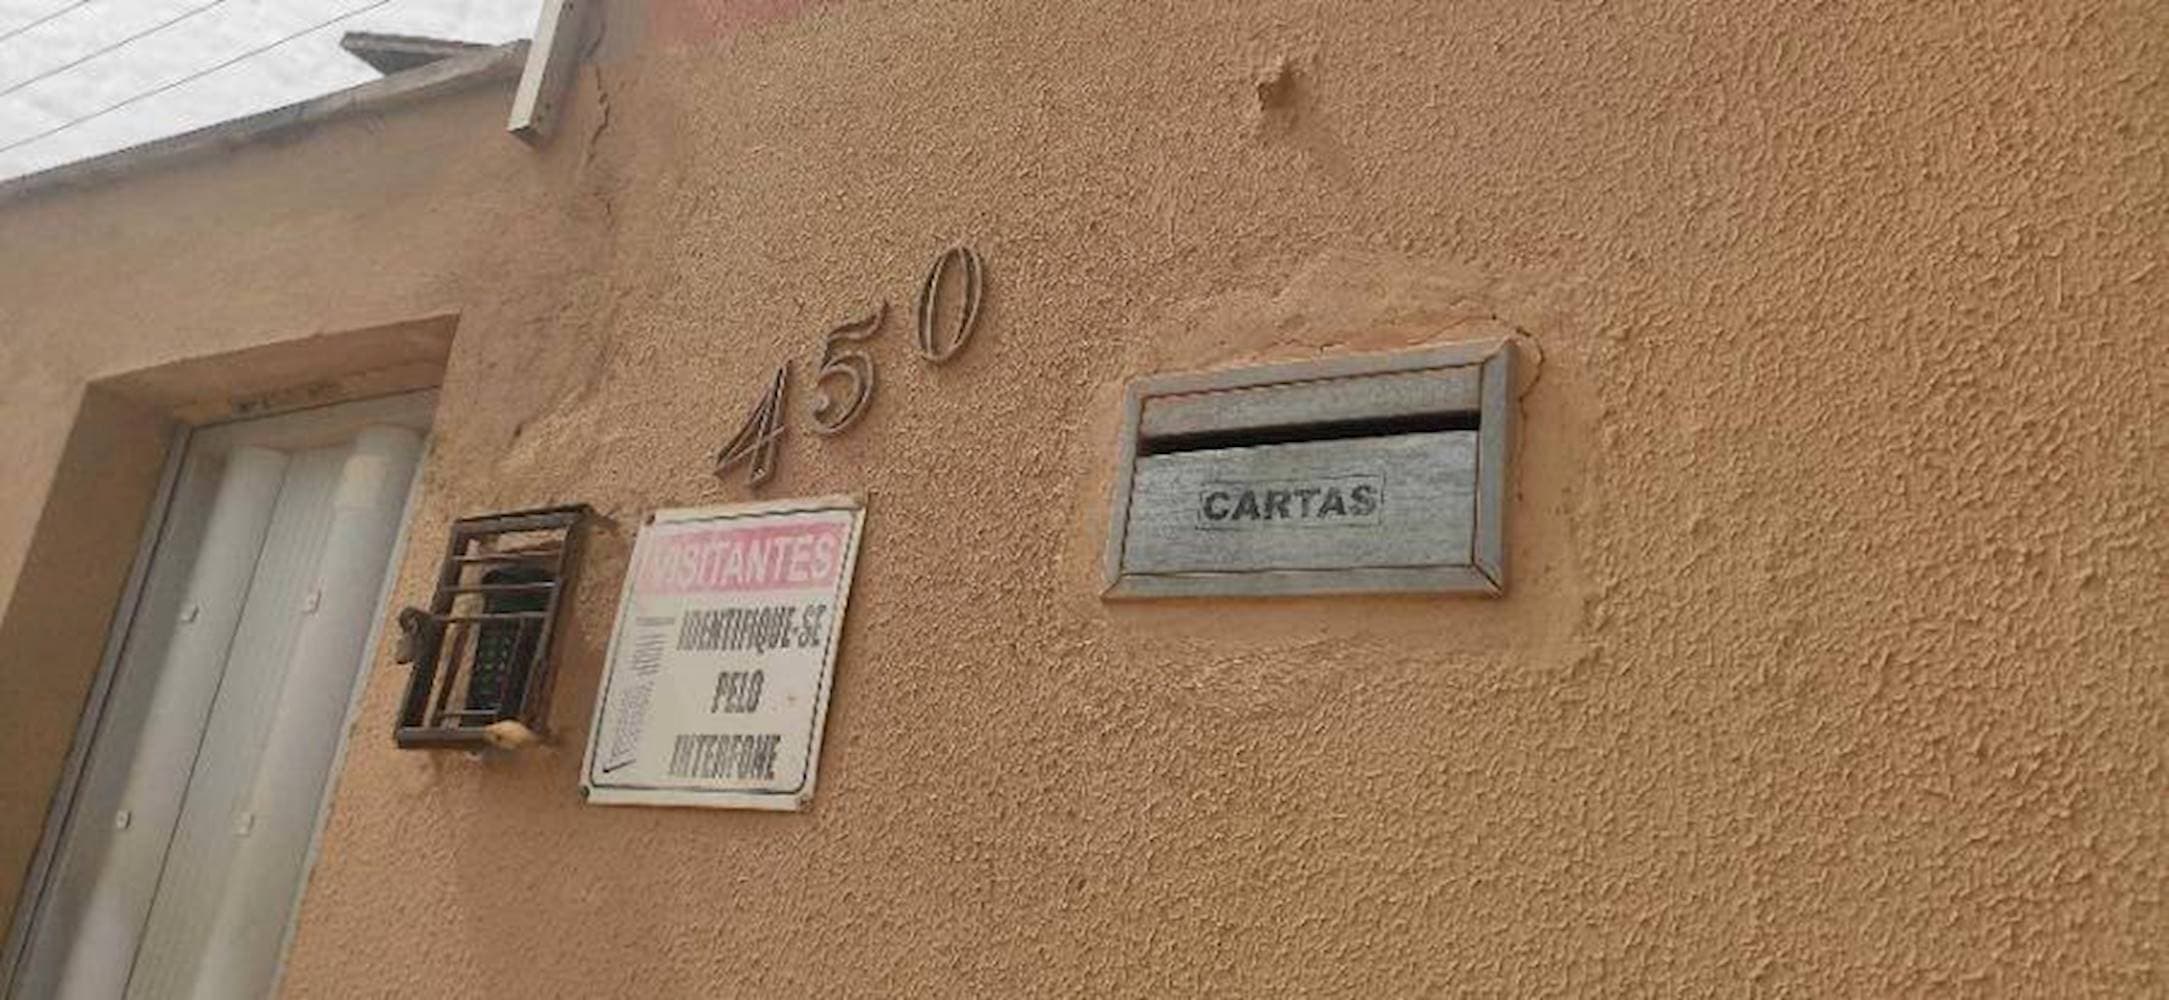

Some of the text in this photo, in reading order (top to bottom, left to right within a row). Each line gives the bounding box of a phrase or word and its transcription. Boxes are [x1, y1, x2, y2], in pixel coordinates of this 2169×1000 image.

[714, 246, 984, 487] 450
[1204, 485, 1377, 521] CARTAS
[652, 532, 838, 586] VISITANTES
[676, 604, 826, 653] IDENTIFIQUE-SE
[711, 669, 764, 714] PELO
[669, 734, 781, 780] INTERFONE
